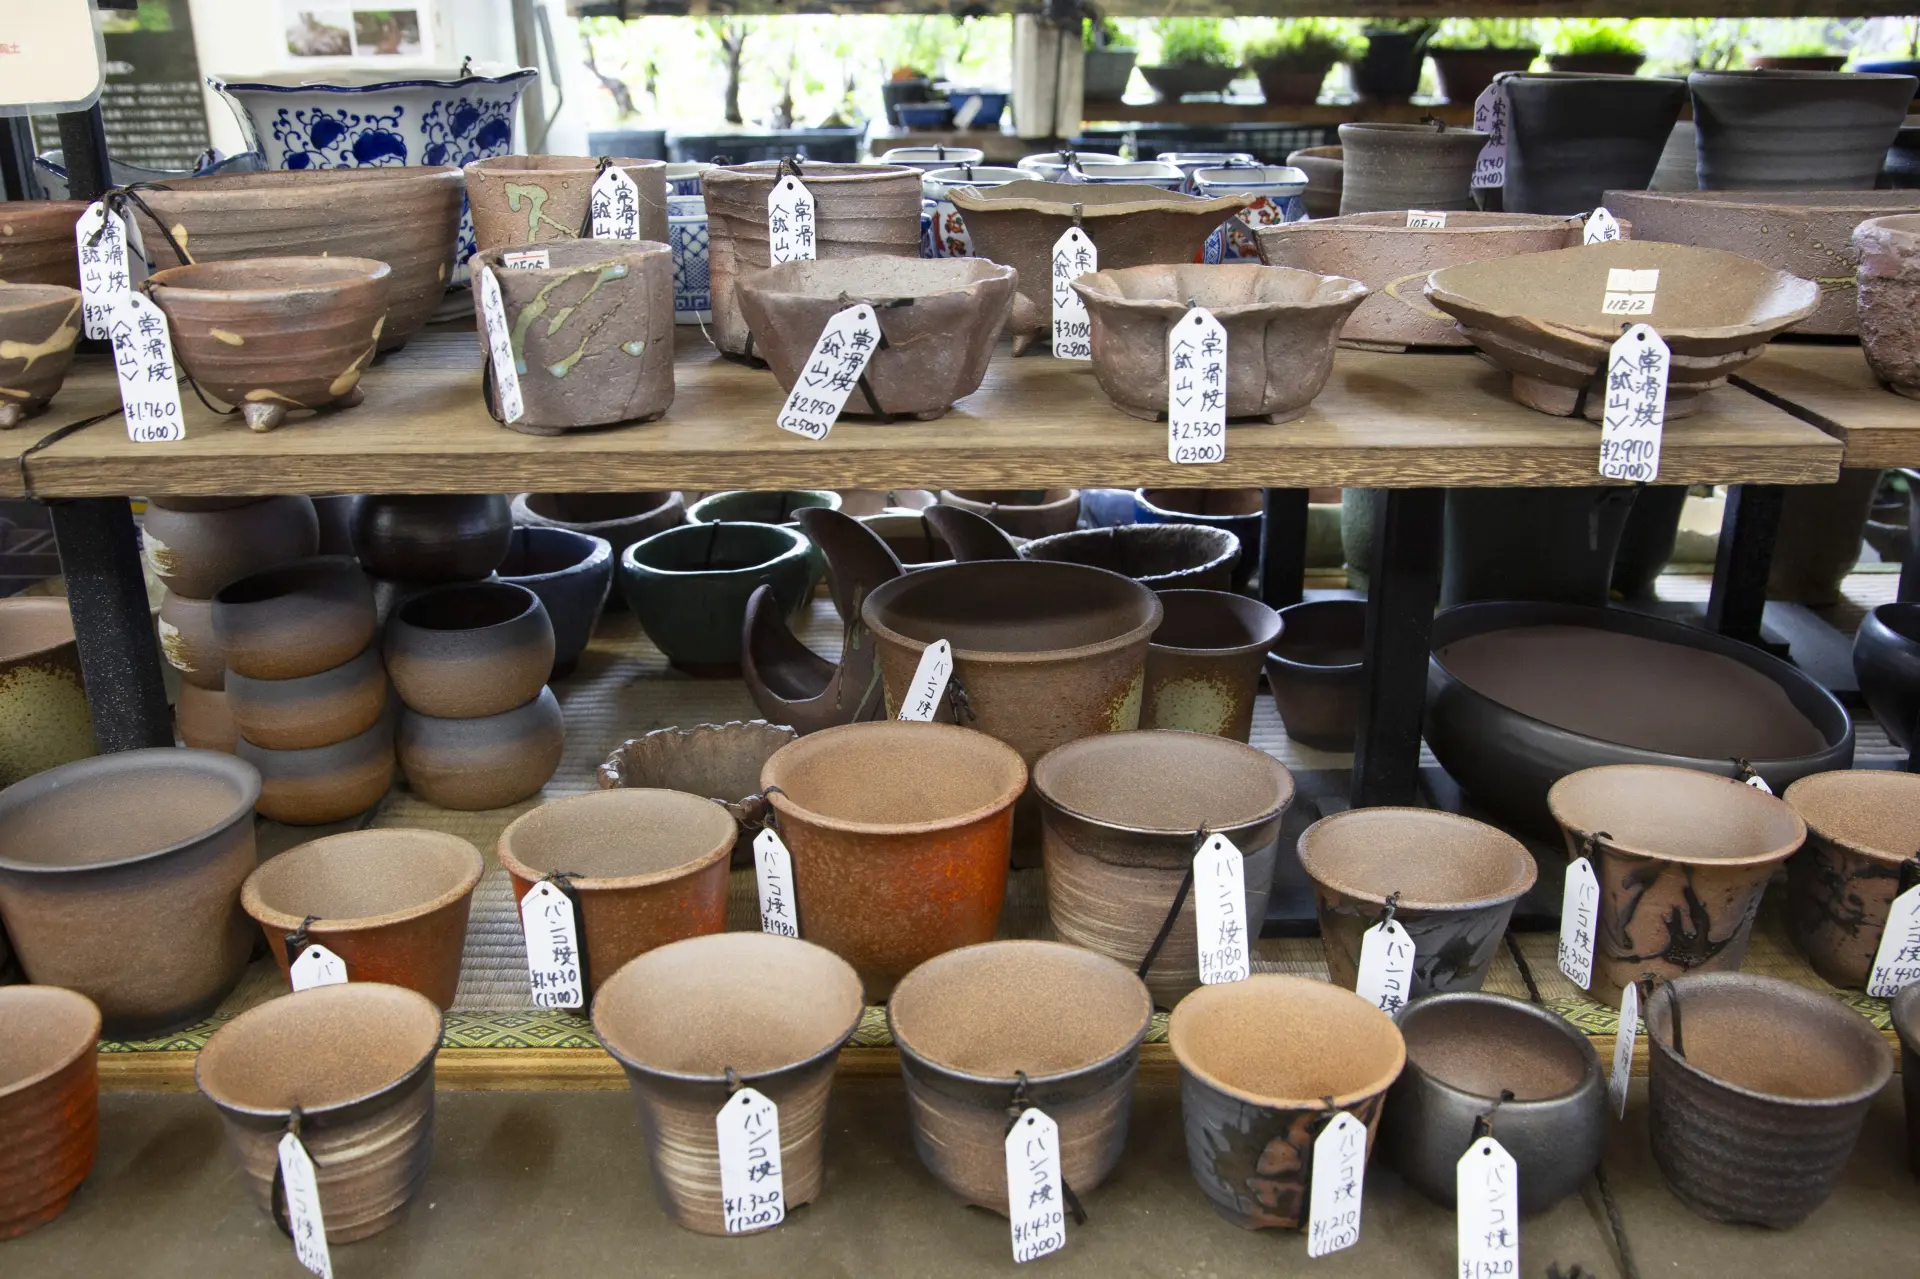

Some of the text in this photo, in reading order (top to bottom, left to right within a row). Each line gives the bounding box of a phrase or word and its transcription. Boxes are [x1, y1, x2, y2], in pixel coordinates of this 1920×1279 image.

[103, 220, 128, 293] 常滑焼
[1607, 299, 1646, 311] 11E12
[138, 312, 172, 381] 常滑焼
[822, 329, 874, 392] 常滑焼
[1055, 342, 1091, 358] (2800
[1201, 329, 1225, 412] 常滑焼
[1630, 347, 1663, 427] 常滑焼
[133, 423, 179, 441] (1600)
[780, 416, 828, 441] (2500)
[1175, 444, 1222, 463] (2300)
[1602, 463, 1653, 481] (2700)
[916, 660, 948, 718] バンコ焼
[764, 852, 788, 917] バンコ焼
[1216, 856, 1242, 945] バンコ焼
[545, 900, 577, 965] バンコ焼
[1574, 883, 1595, 953] バンコ焼
[535, 988, 579, 1006] (1300)
[1379, 942, 1410, 1014] バンコ焼
[1871, 985, 1906, 997] (130
[744, 1107, 781, 1183] バンコ焼
[1027, 1127, 1054, 1209] バンコ焼
[1333, 1128, 1362, 1204] バンコ焼
[729, 1206, 781, 1233] (1200)
[1484, 1164, 1517, 1250] バンコ焼
[1018, 1231, 1062, 1263] (1300)
[1315, 1227, 1358, 1257] (1100)
